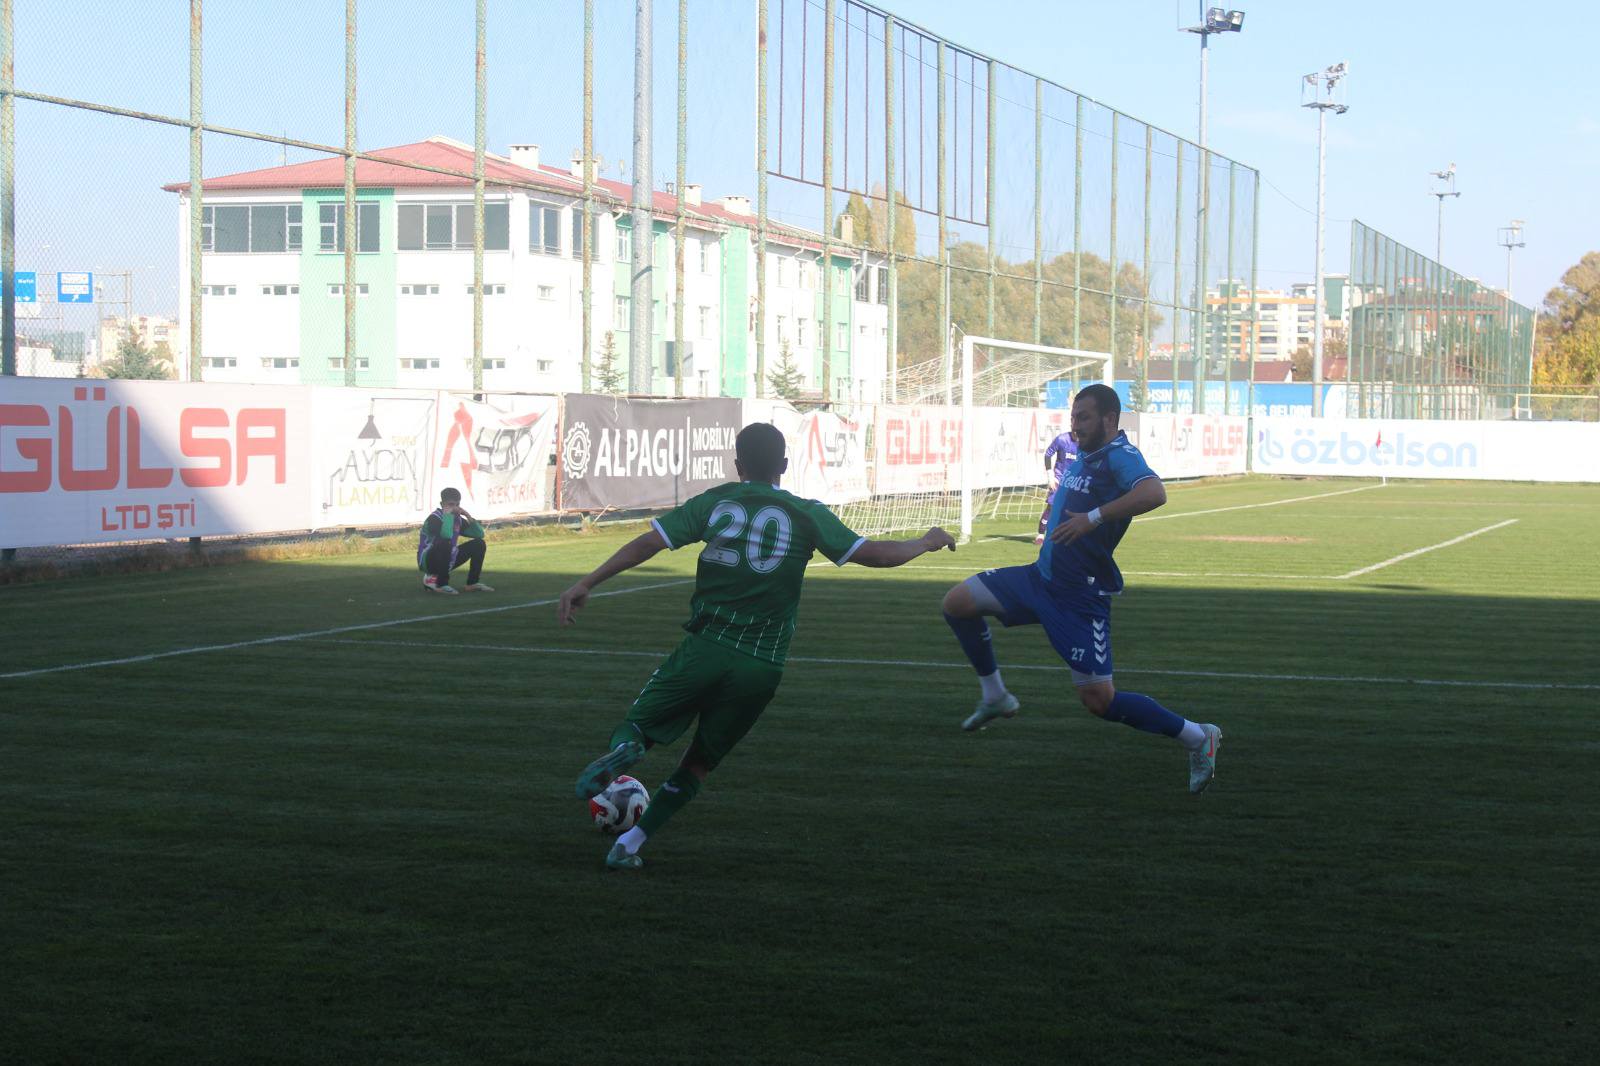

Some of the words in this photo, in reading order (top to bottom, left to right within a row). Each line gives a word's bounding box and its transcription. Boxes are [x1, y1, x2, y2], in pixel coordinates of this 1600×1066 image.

[0, 387, 286, 493] GÜLSA
[594, 428, 684, 477] ALPAGU
[692, 422, 736, 451] MOBİLYA
[886, 410, 963, 465] GÜLS
[1290, 429, 1477, 467] özbelsan
[692, 456, 725, 480] METAL
[337, 485, 409, 507] LAMBA
[102, 504, 150, 531] LTD
[157, 499, 195, 530] ŞTİ
[700, 499, 793, 573] 20
[1071, 648, 1085, 661] 27
